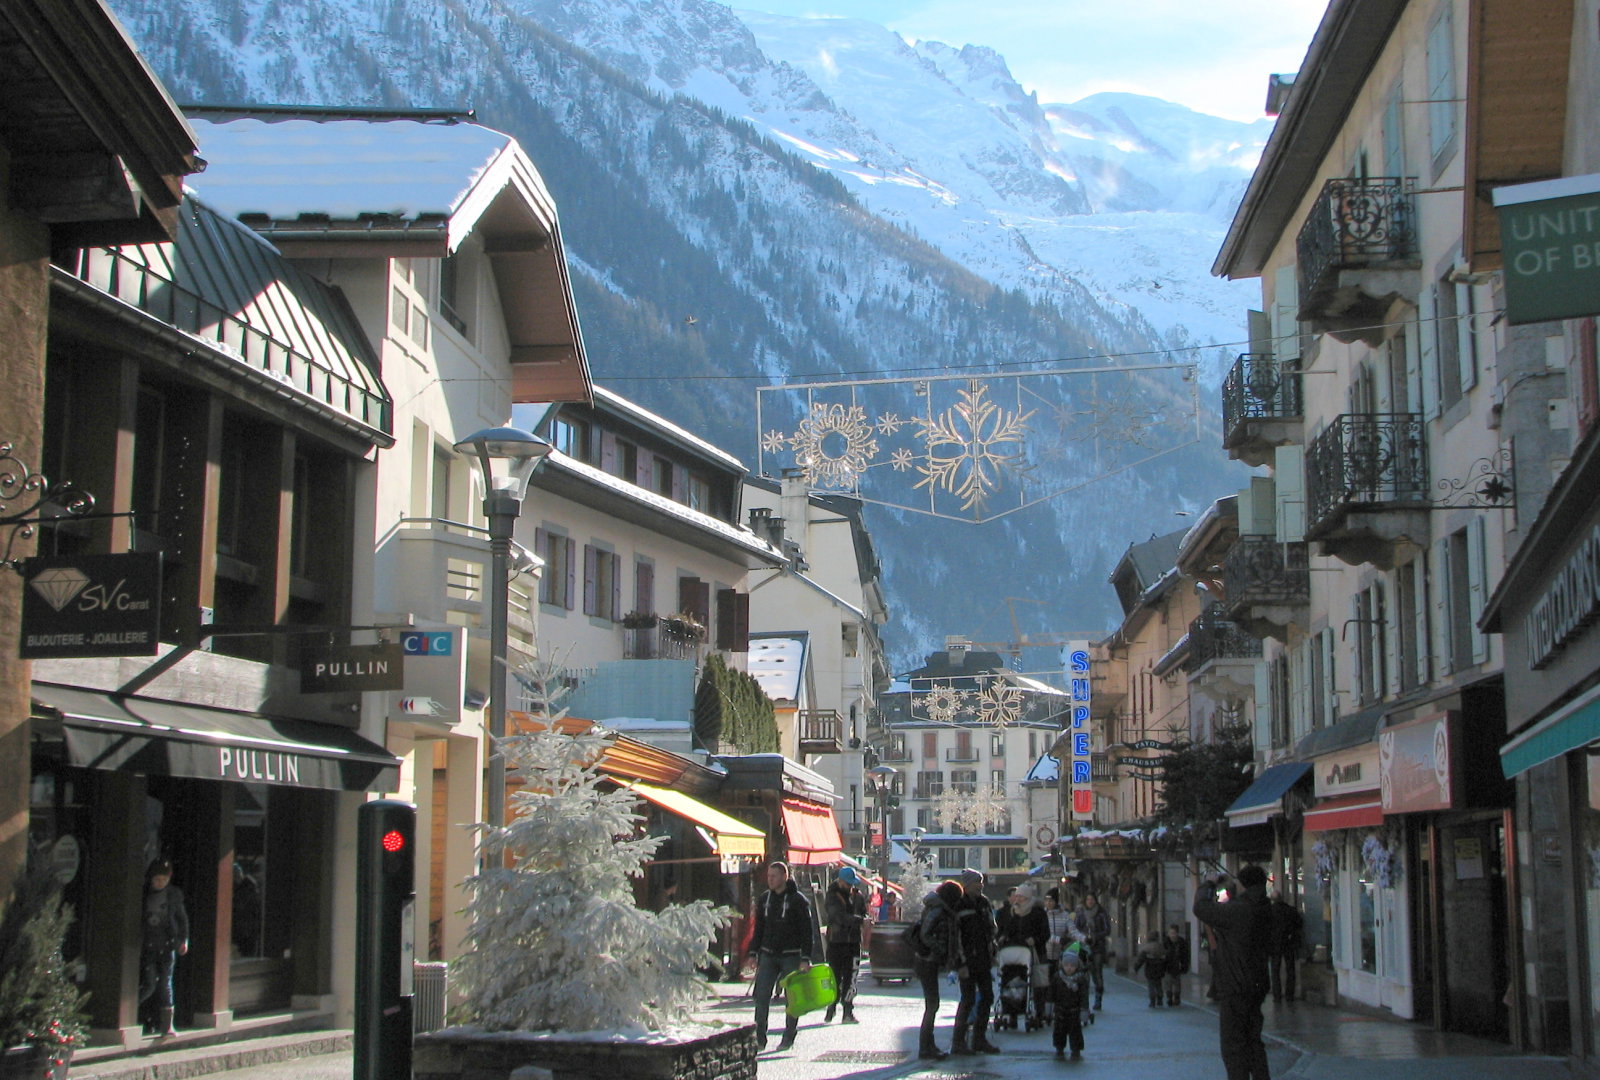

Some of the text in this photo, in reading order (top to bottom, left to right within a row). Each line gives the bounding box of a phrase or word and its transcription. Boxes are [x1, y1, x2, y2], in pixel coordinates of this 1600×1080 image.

[1514, 247, 1561, 275] OF
[27, 633, 85, 647] BIJOUTERIE
[91, 631, 148, 644] JOAILLERIE
[403, 635, 448, 652] CIC
[315, 660, 389, 677] PULLIN
[1070, 650, 1092, 813] SUPER U
[1135, 741, 1160, 749] PAYOT
[219, 747, 300, 784] PULLIN
